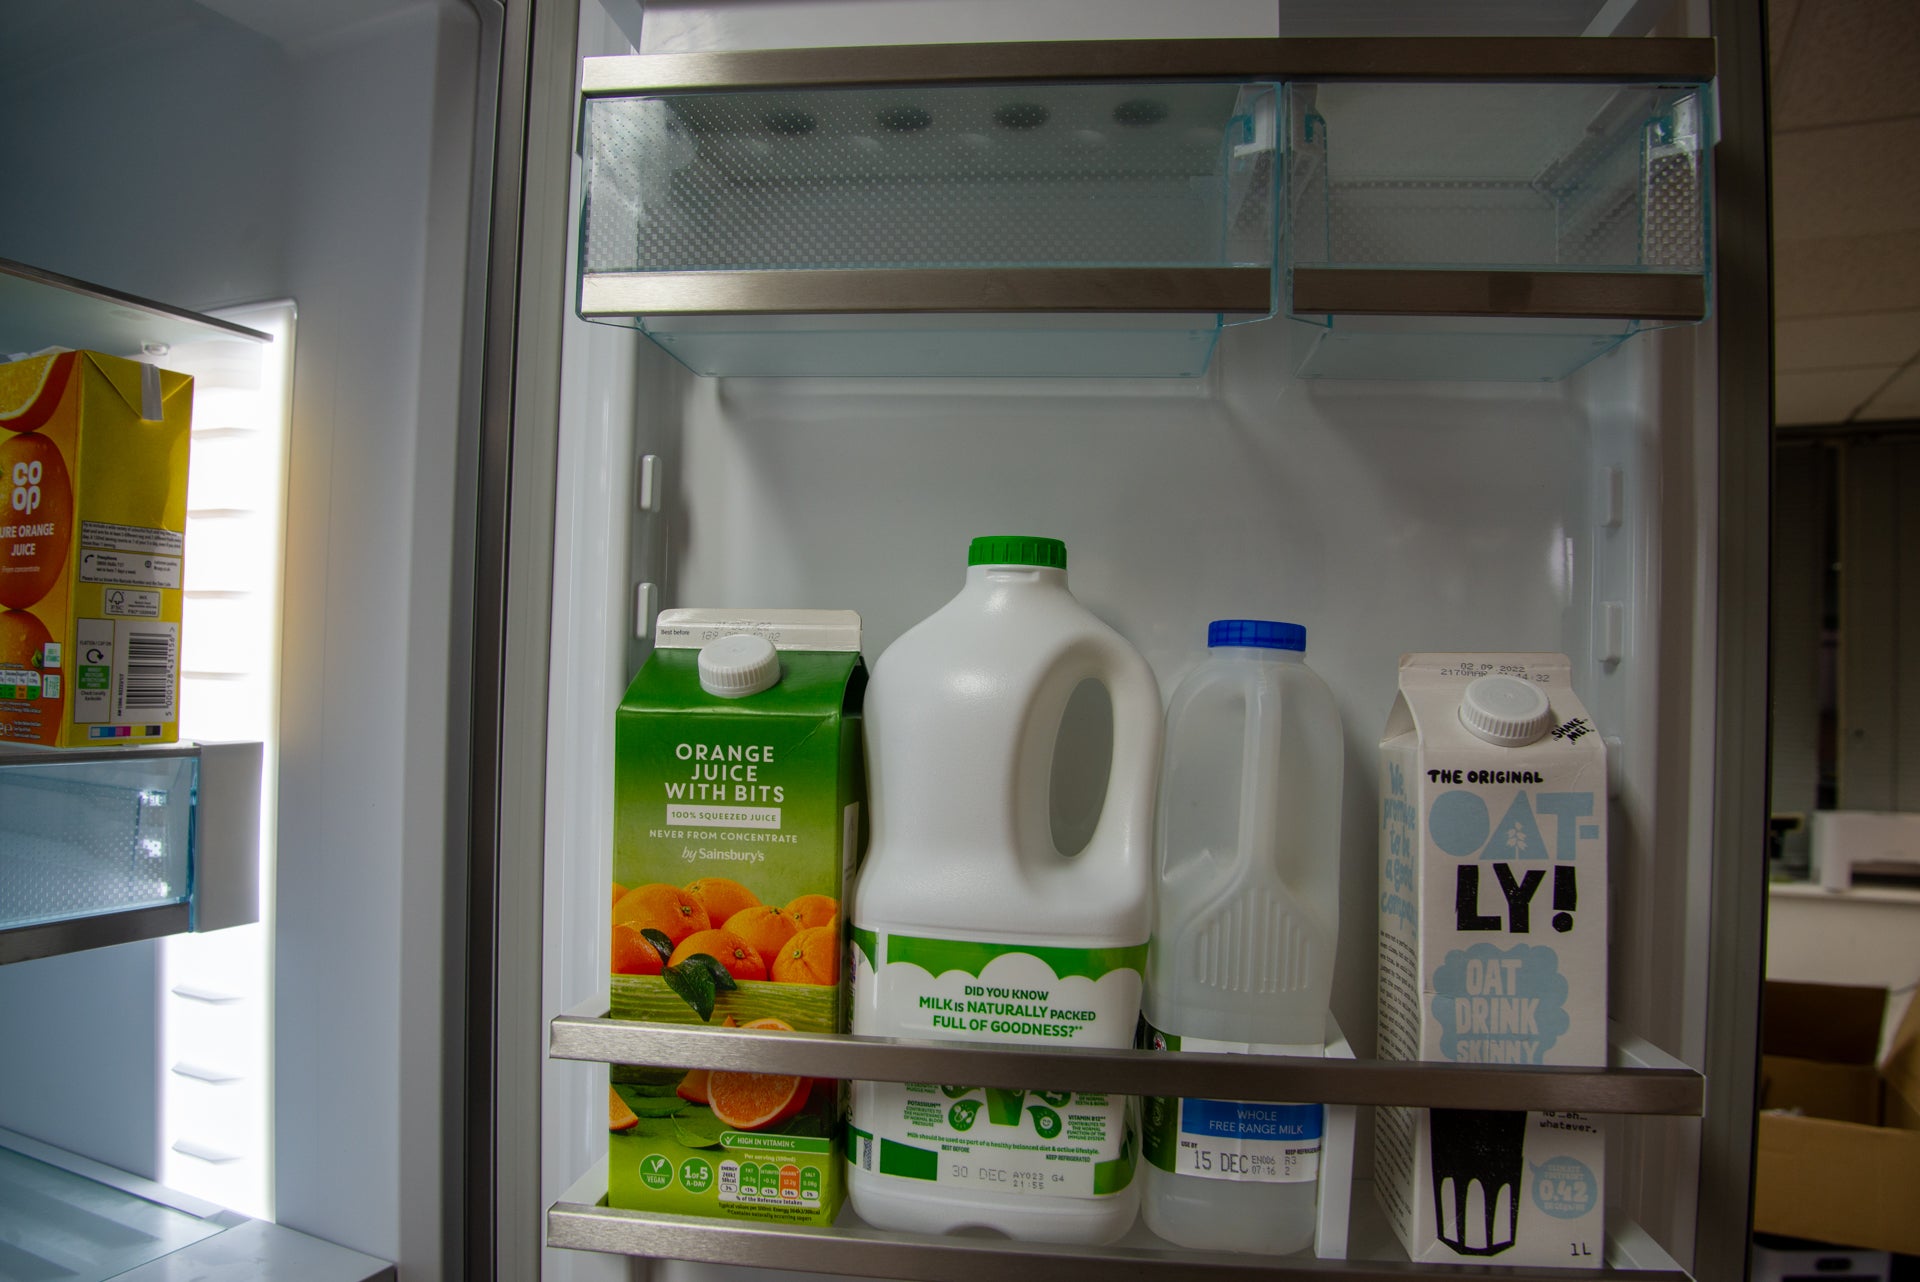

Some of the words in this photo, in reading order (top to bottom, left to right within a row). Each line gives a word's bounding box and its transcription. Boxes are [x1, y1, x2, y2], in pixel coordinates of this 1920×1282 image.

[0, 526, 17, 538] URE
[18, 522, 55, 538] ORANGE
[11, 542, 36, 556] JUICE
[1552, 718, 1585, 739] SHAKE
[1567, 725, 1591, 741] ME!
[675, 743, 774, 762] ORANGE
[691, 764, 758, 782] JUICE
[1428, 769, 1463, 784] THE
[1467, 770, 1544, 784] ORIGINAL
[664, 783, 726, 800] WITH
[735, 785, 785, 803] BITS
[671, 811, 696, 819] 100%
[699, 812, 748, 821] SQUEEZED
[750, 813, 776, 822] JUICE
[1428, 790, 1599, 860] OAT-
[649, 830, 684, 840] NEVER
[687, 831, 717, 840] FROM
[720, 832, 797, 843] CONCENTRATE
[682, 846, 698, 862] by
[699, 848, 764, 862] Sainsbury's
[1455, 863, 1577, 933] LY!
[1466, 959, 1522, 996] OAT
[964, 985, 984, 997] DID
[986, 987, 1009, 999] YOU
[1012, 989, 1049, 1001] KNOW
[919, 996, 953, 1011] MILK
[954, 1002, 964, 1012] IS
[968, 1001, 1049, 1019] NATURALLY
[1050, 1010, 1096, 1021] PACKED
[1456, 998, 1540, 1034] DRINK
[933, 1016, 967, 1030] FULL
[970, 1018, 987, 1032] OF
[1456, 1040, 1539, 1064] SKINNY
[1237, 1110, 1277, 1121] WHOLE
[1209, 1120, 1235, 1131] FREE
[1239, 1123, 1276, 1134] RANGE
[1279, 1124, 1304, 1134] MILK
[1540, 1120, 1597, 1133] whatever.
[763, 1138, 789, 1147] VITAMIN
[991, 1141, 1012, 1150] healthy
[1013, 1143, 1039, 1151] balanced
[1058, 1155, 1091, 1163] REFRIGERATED
[1194, 1151, 1212, 1170] 15
[1220, 1154, 1248, 1174] DEC
[647, 1176, 665, 1184] VEGAN
[952, 1165, 968, 1178] 30
[979, 1168, 1007, 1182] DEC
[1539, 1180, 1588, 1202] 0.42
